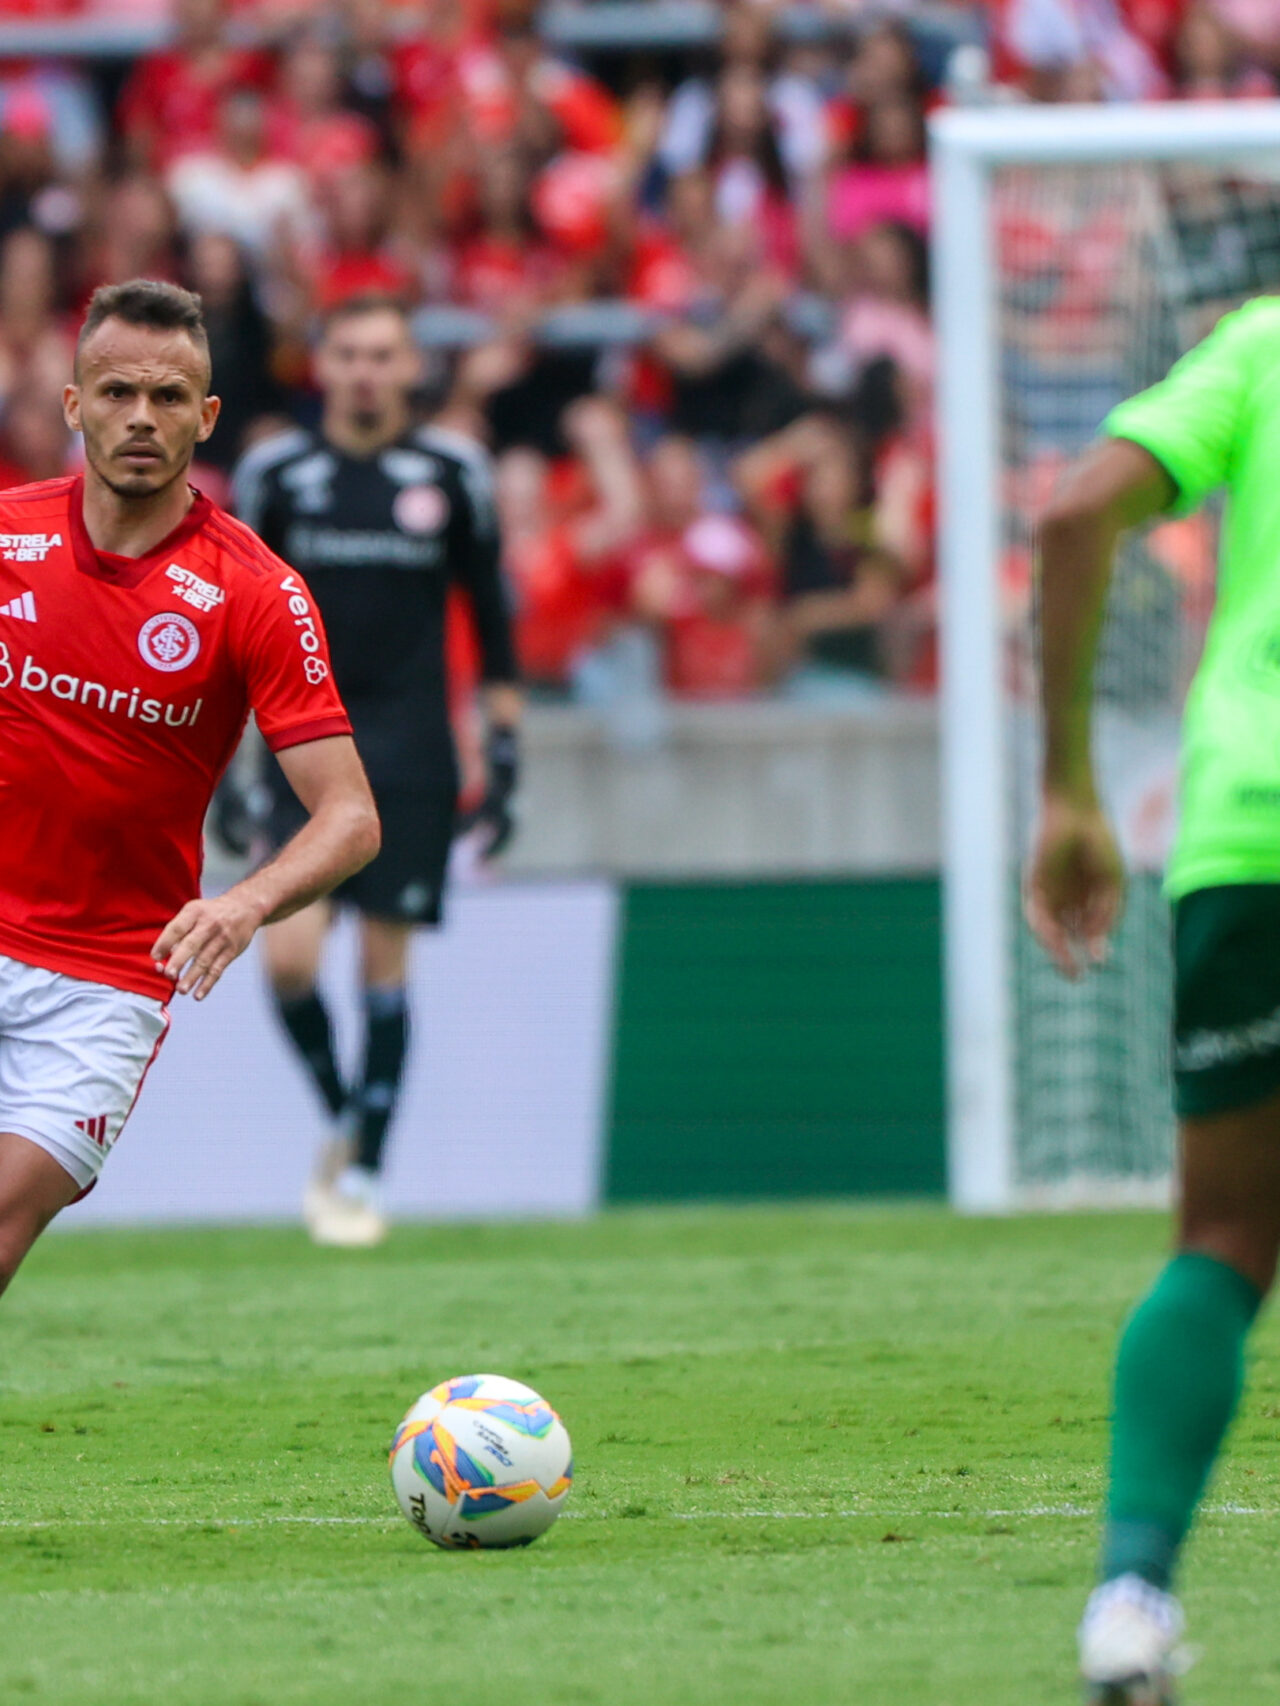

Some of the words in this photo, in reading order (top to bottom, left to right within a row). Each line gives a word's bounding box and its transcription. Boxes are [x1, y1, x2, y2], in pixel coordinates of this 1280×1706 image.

[16, 547, 50, 562] BET
[182, 588, 218, 613] BET
[280, 575, 320, 653] vero
[20, 655, 203, 728] banrisul
